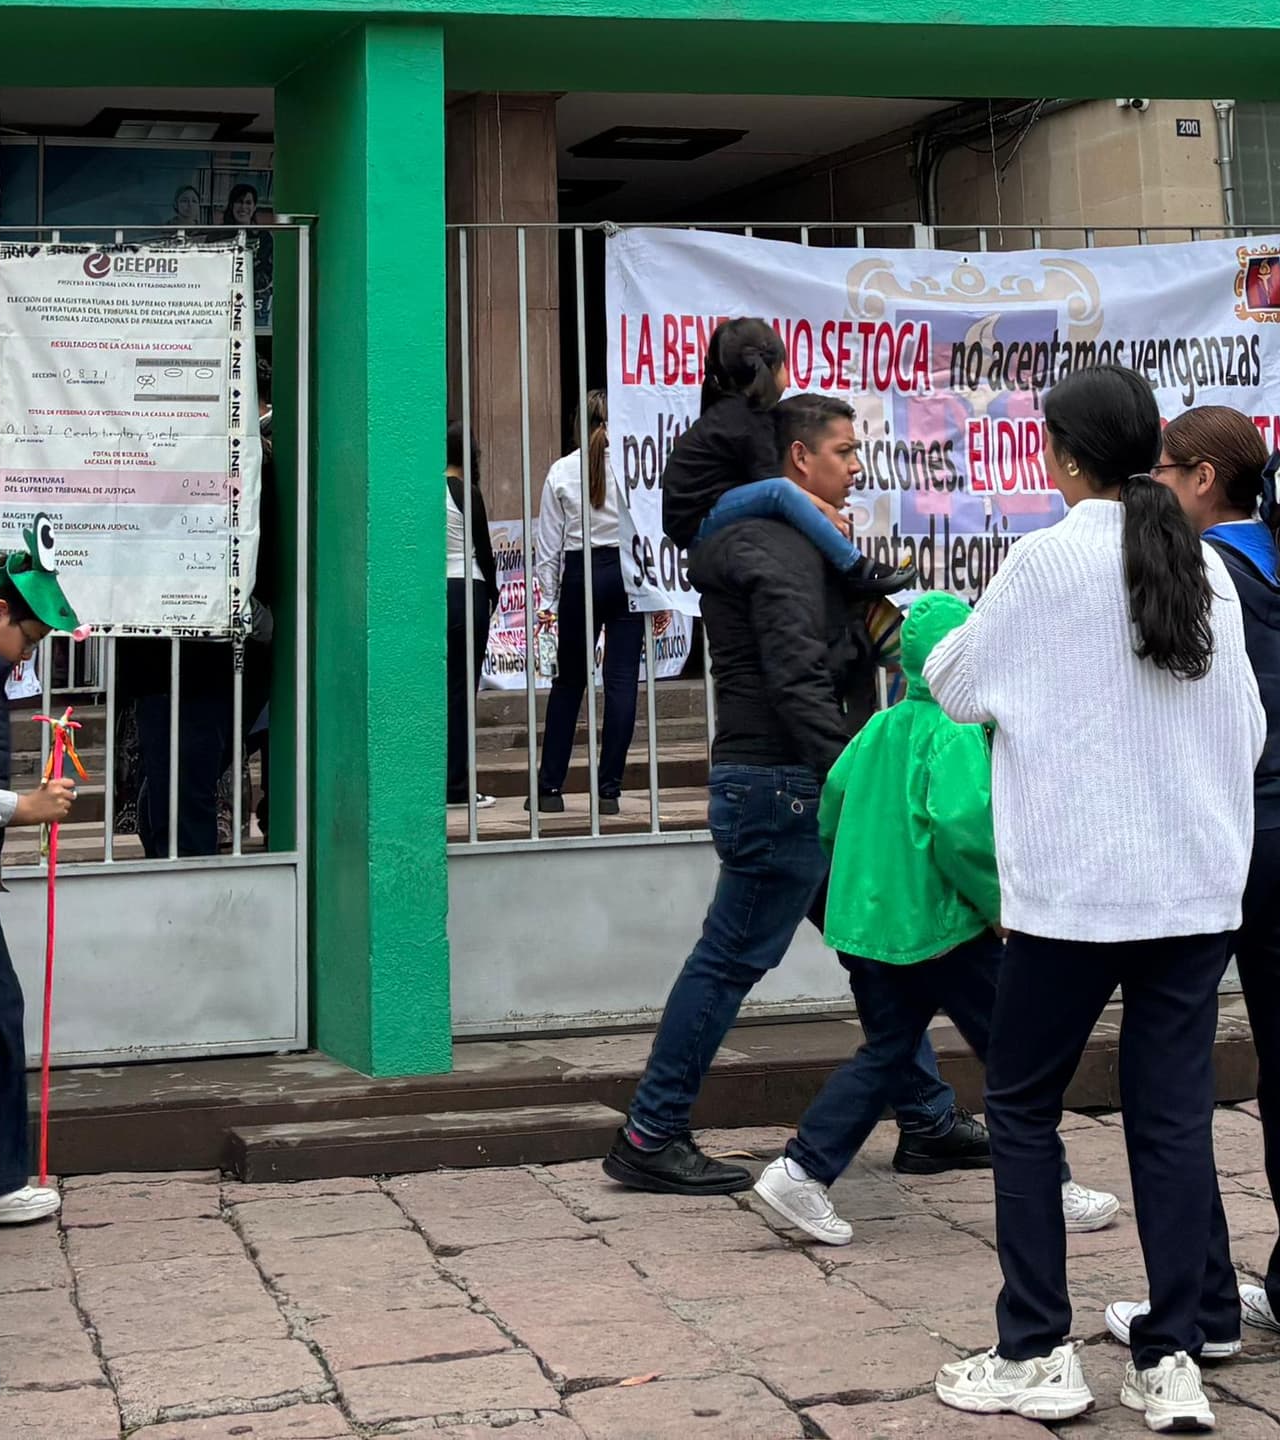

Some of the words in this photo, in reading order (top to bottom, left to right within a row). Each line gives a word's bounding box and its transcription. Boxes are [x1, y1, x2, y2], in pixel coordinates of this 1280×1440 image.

[113, 256, 179, 274] CEEPAC
[42, 296, 53, 304] DE
[54, 297, 115, 306] MAGISTRATURAS
[116, 298, 130, 306] DEL
[203, 301, 214, 309] DE
[25, 305, 87, 314] MAGISTRATURAS
[87, 307, 101, 315] DEL
[140, 308, 150, 316] DE
[51, 340, 98, 350] RESULTADOS
[99, 342, 109, 350] DE
[109, 342, 119, 350] LA
[120, 342, 151, 351] CASILLA
[152, 343, 193, 351] SECCIONAL
[621, 313, 655, 385] LA
[820, 320, 852, 391] SE
[857, 321, 931, 392] TOCA
[949, 340, 983, 388] no
[1131, 334, 1261, 407] venganzas
[5, 476, 65, 485] MAGISTRATURAS
[4, 485, 19, 494] DEL
[20, 486, 54, 494] SUPREMO
[55, 486, 91, 495] TRIBUNAL
[92, 486, 103, 495] DE
[104, 486, 136, 496] JUSTICIA
[631, 534, 658, 588] se
